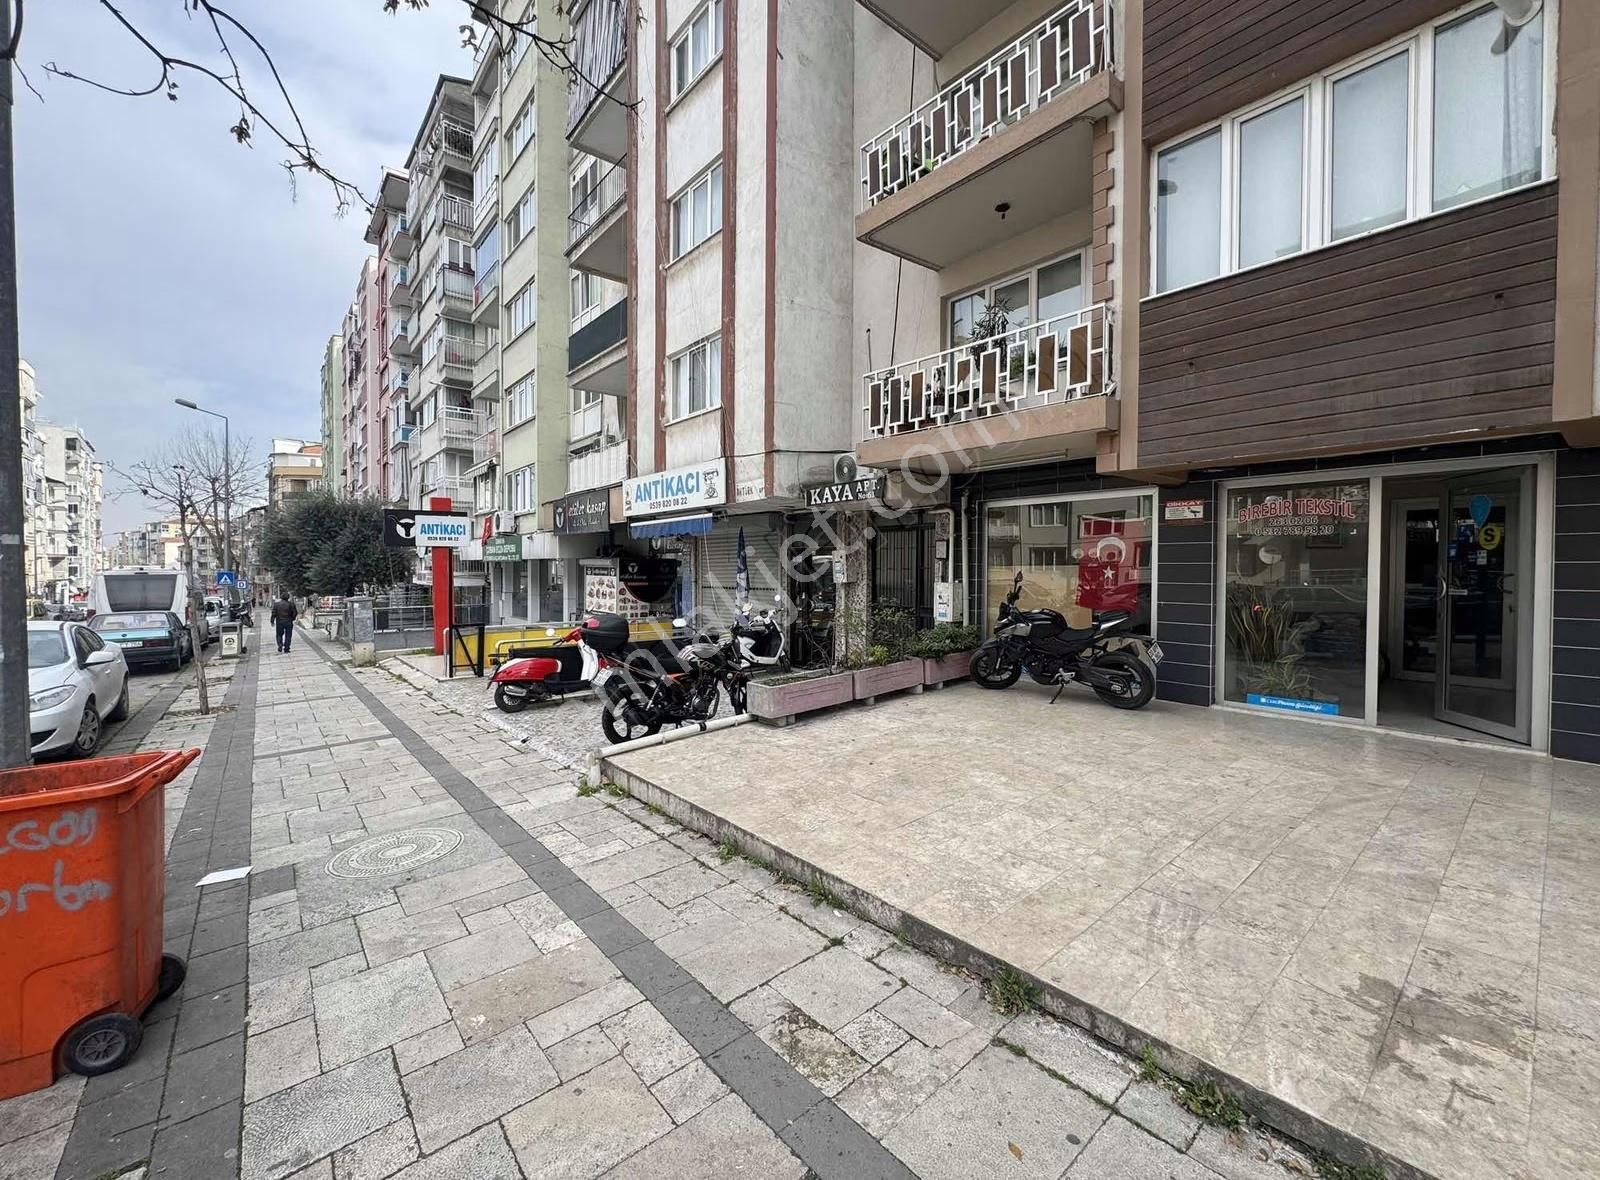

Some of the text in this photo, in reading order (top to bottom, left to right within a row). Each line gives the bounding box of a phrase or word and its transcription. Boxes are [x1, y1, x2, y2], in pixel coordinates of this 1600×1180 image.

[635, 471, 700, 504] ANTİKACI
[810, 479, 880, 506] KAYA APT.
[680, 496, 688, 506] 22
[1238, 496, 1356, 523] BİREBİR TEKSTİL
[420, 522, 466, 536] ANTİKACI
[1484, 528, 1495, 542] S
